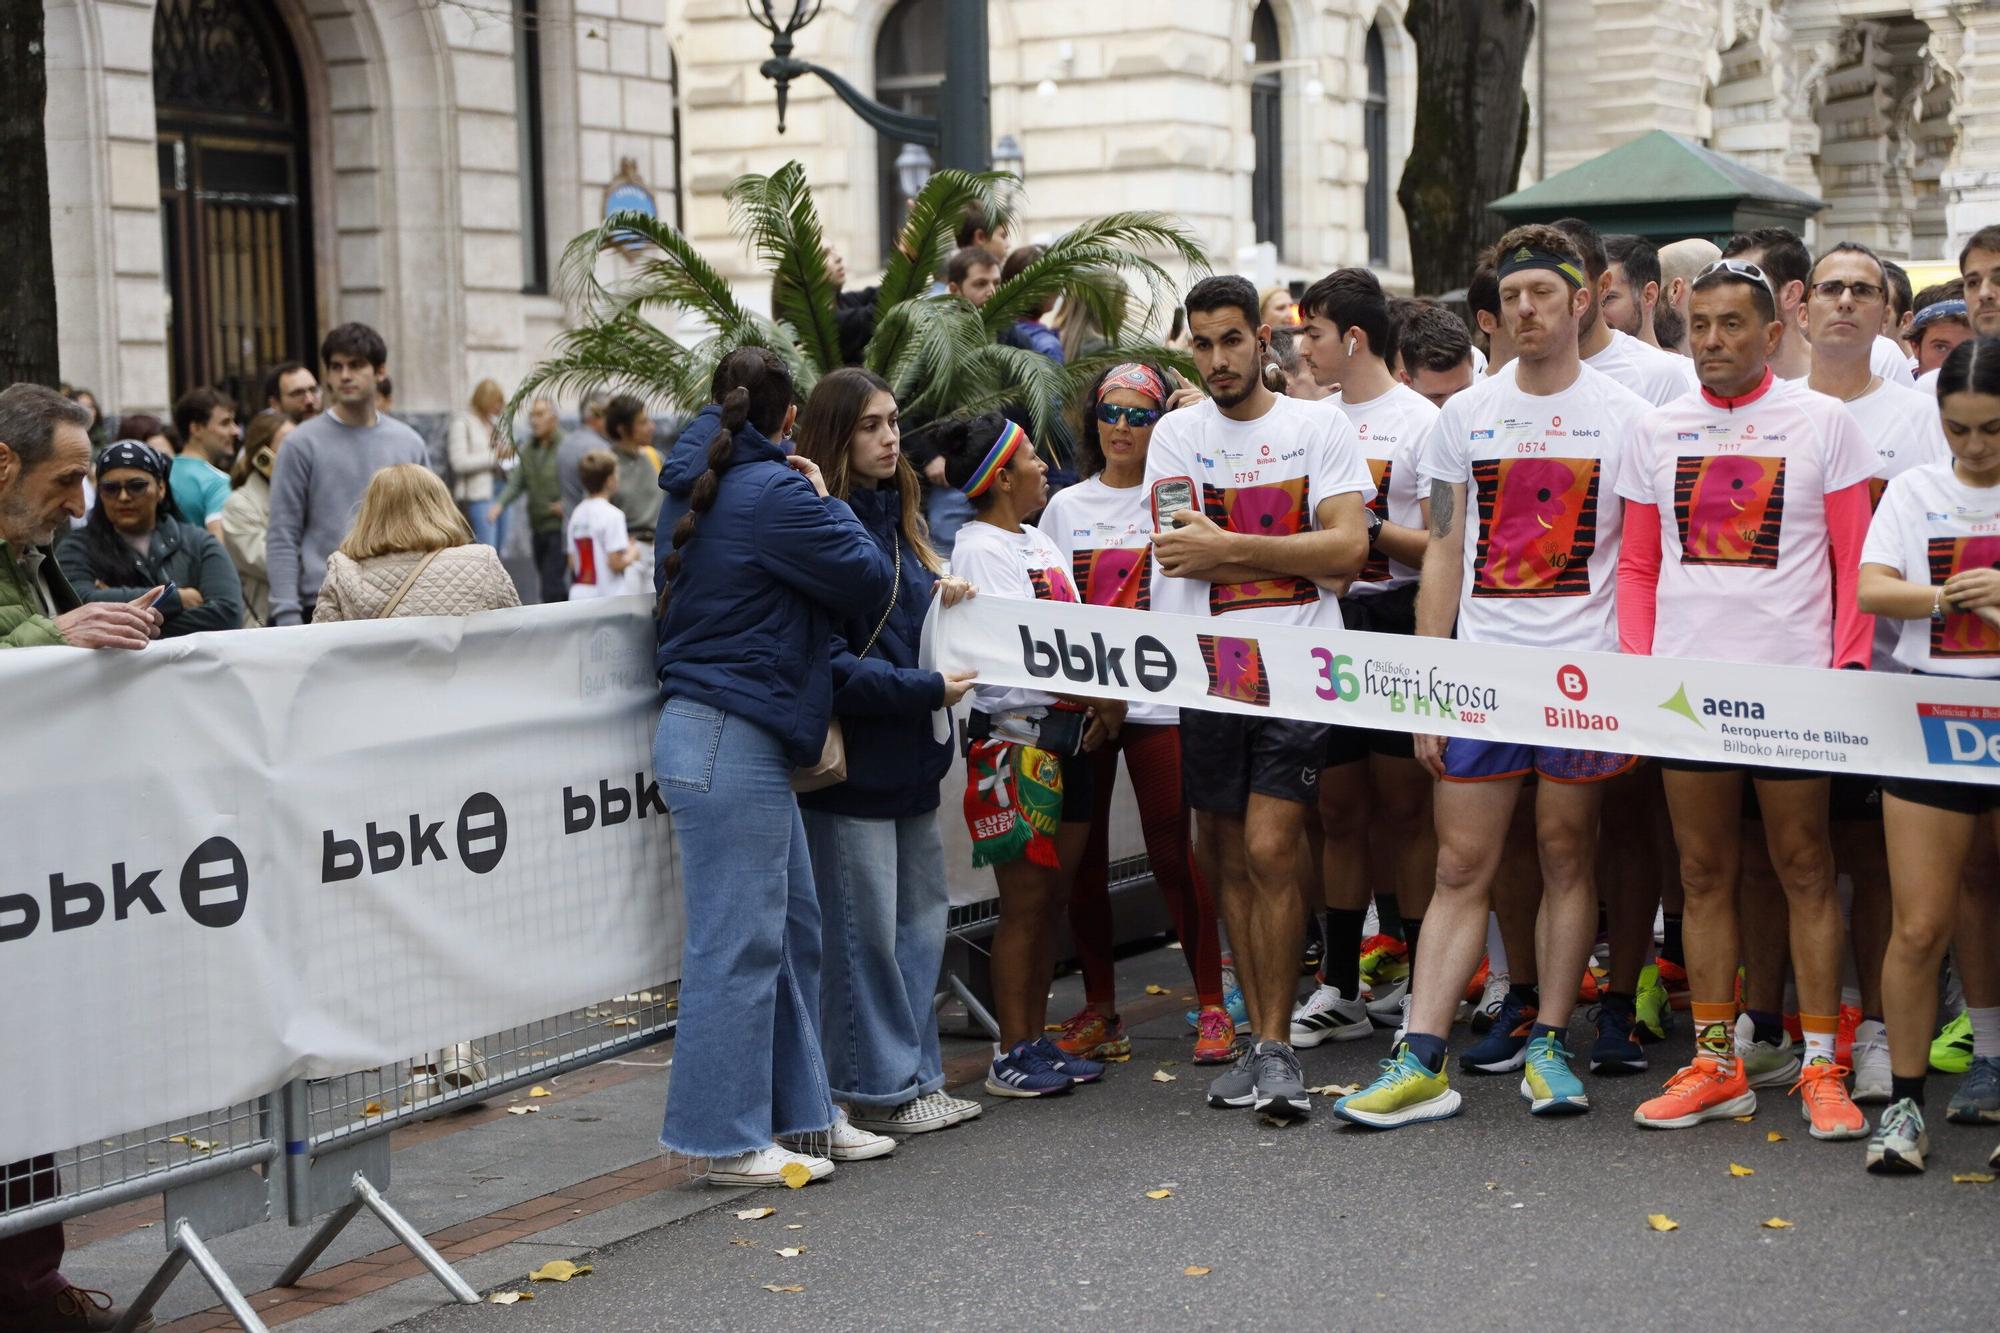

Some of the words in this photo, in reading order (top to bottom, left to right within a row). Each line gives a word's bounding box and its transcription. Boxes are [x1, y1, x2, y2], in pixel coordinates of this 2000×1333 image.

[1572, 429, 1592, 437] bbk
[1517, 442, 1547, 453] 0574
[1717, 443, 1742, 452] 7117
[1234, 470, 1260, 483] 5797
[1549, 552, 1568, 568] 10
[1017, 624, 1130, 688] bbk
[1309, 647, 1361, 703] 36
[1373, 660, 1411, 677] Bilboko
[1364, 658, 1500, 713] herrikrosa
[1460, 710, 1487, 725] 2025
[1543, 706, 1619, 732] Bilbao
[1702, 696, 1766, 721] aena
[1720, 723, 1800, 743] Aeropuerto
[1801, 729, 1821, 743] de
[1823, 731, 1869, 747] Bilbao
[1723, 739, 1773, 758] Bilboko
[1775, 747, 1848, 764] Aireportua
[562, 772, 669, 835] bbk
[321, 812, 448, 883] bbk
